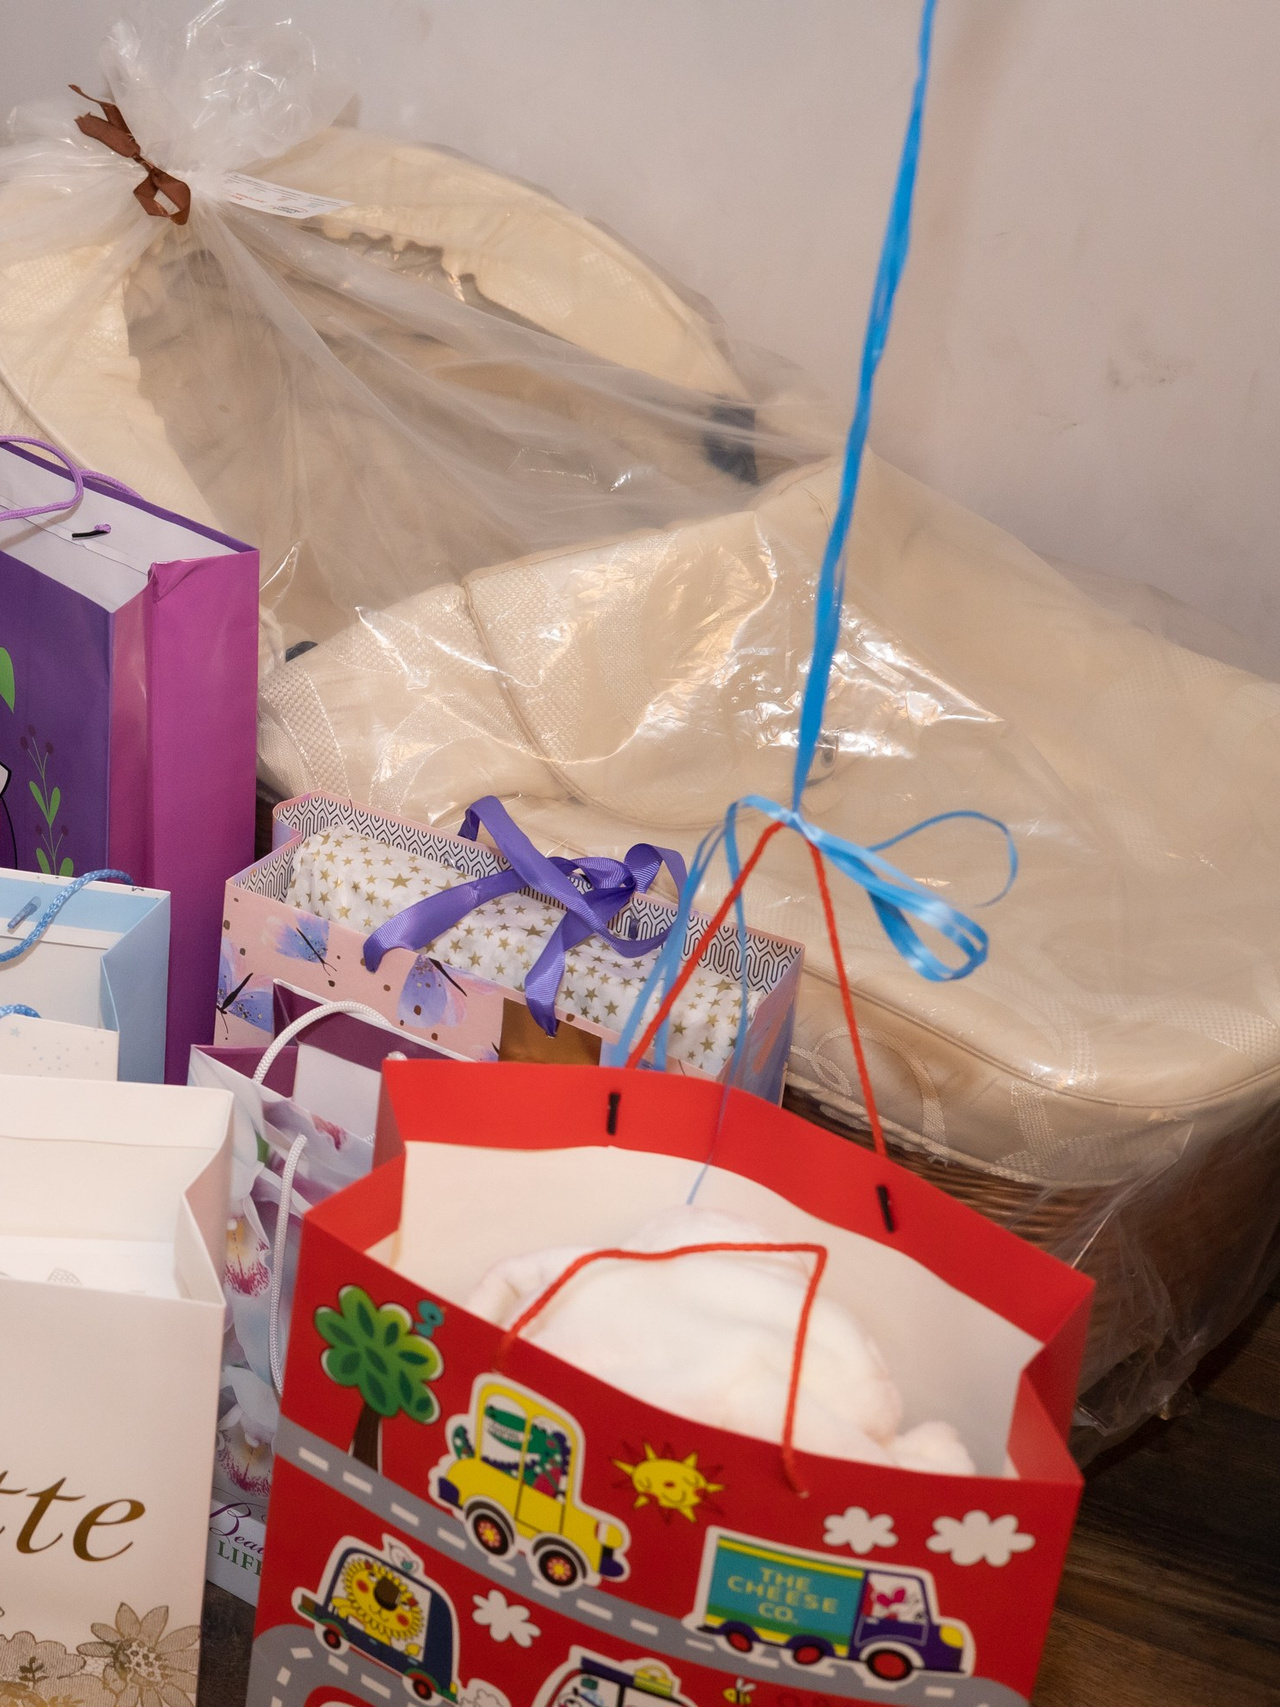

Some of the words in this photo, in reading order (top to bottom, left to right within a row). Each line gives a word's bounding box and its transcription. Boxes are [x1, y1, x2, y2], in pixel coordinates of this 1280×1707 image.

[760, 1567, 811, 1592] THE
[727, 1576, 839, 1614] CHEESE
[757, 1603, 798, 1625] CO.
